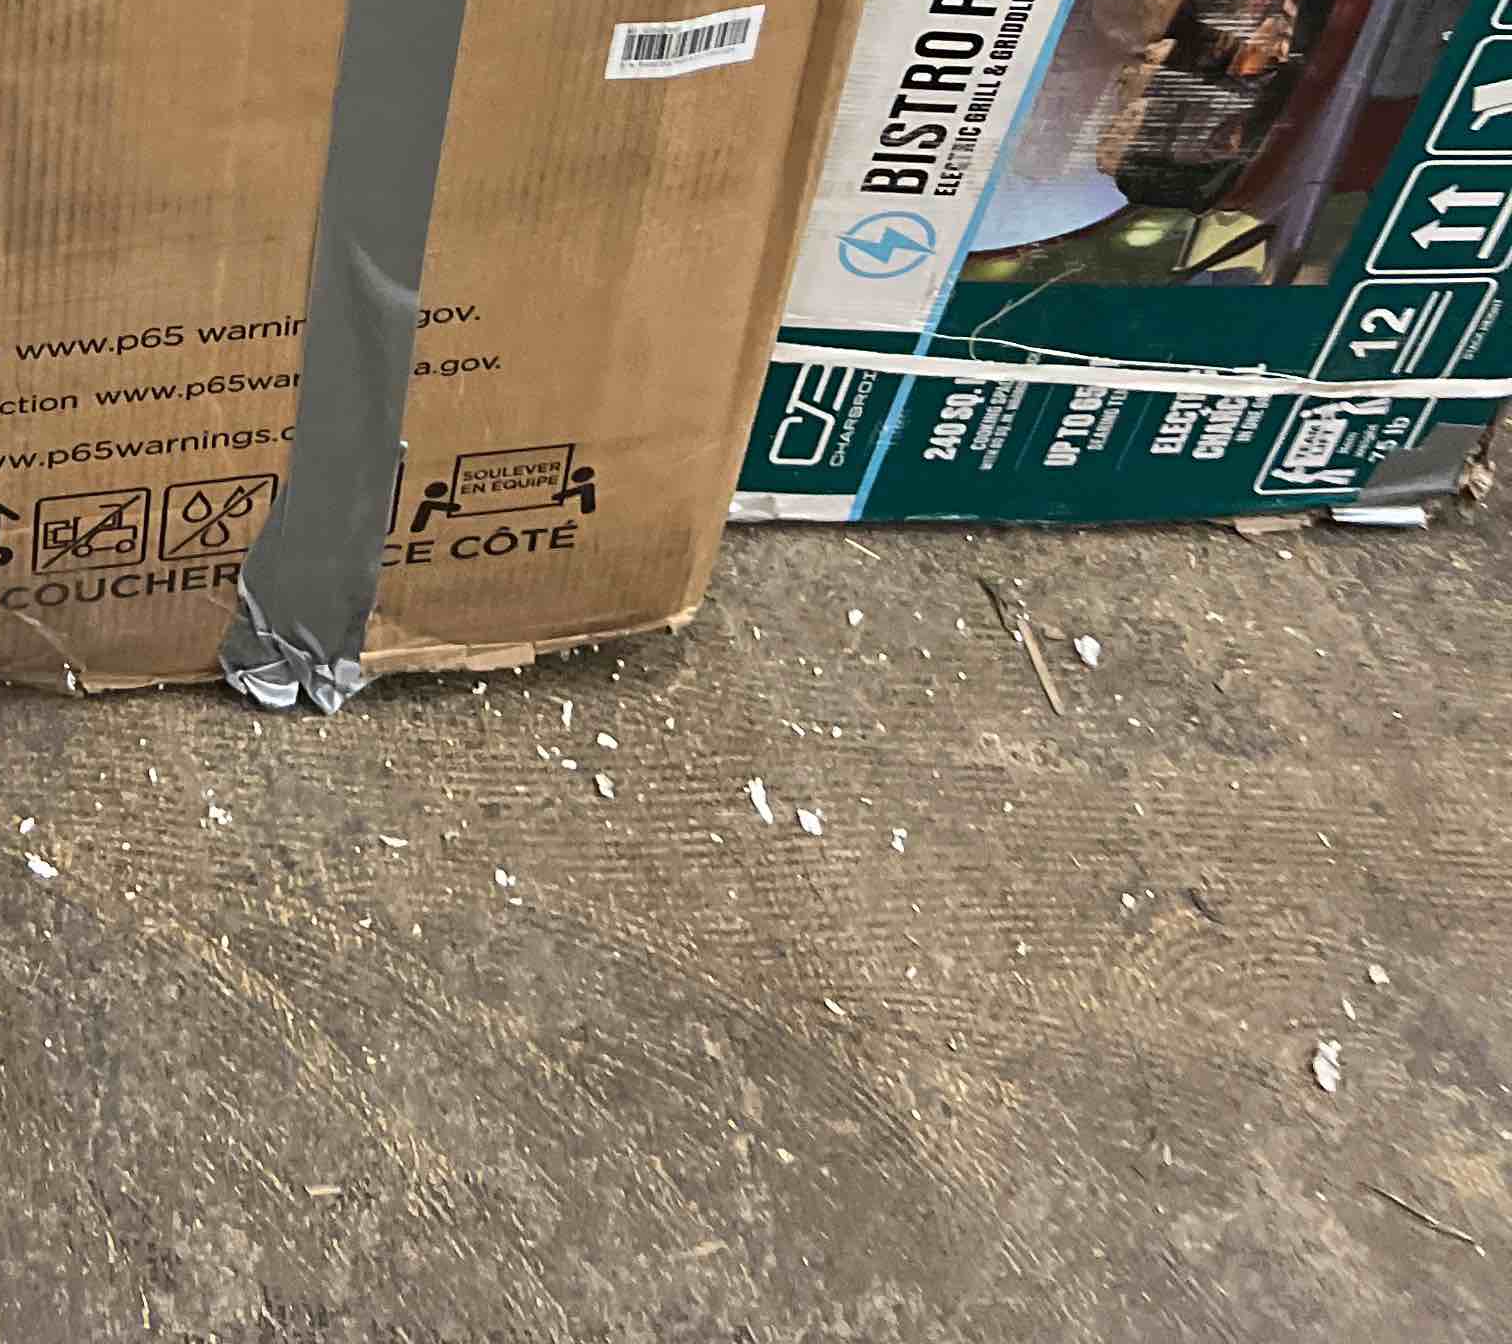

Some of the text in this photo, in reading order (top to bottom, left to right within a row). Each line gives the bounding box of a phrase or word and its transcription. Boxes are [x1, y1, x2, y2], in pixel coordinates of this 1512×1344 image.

[861, 30, 984, 196] BISTRO
[934, 121, 981, 197] ELECTRIC
[970, 80, 1001, 123] GRILL
[989, 59, 1007, 77] &
[16, 325, 185, 361] www.p65
[1349, 308, 1416, 360] 12
[829, 369, 878, 467] CHARBROI
[940, 388, 985, 420] SQ.
[923, 423, 967, 461] 240
[1057, 414, 1095, 439] TO
[463, 461, 561, 482] SOULEVER
[1044, 441, 1080, 466] UP
[460, 483, 486, 495] EN
[0, 562, 241, 611] COUCHER
[450, 519, 578, 560] CÔTÉ
